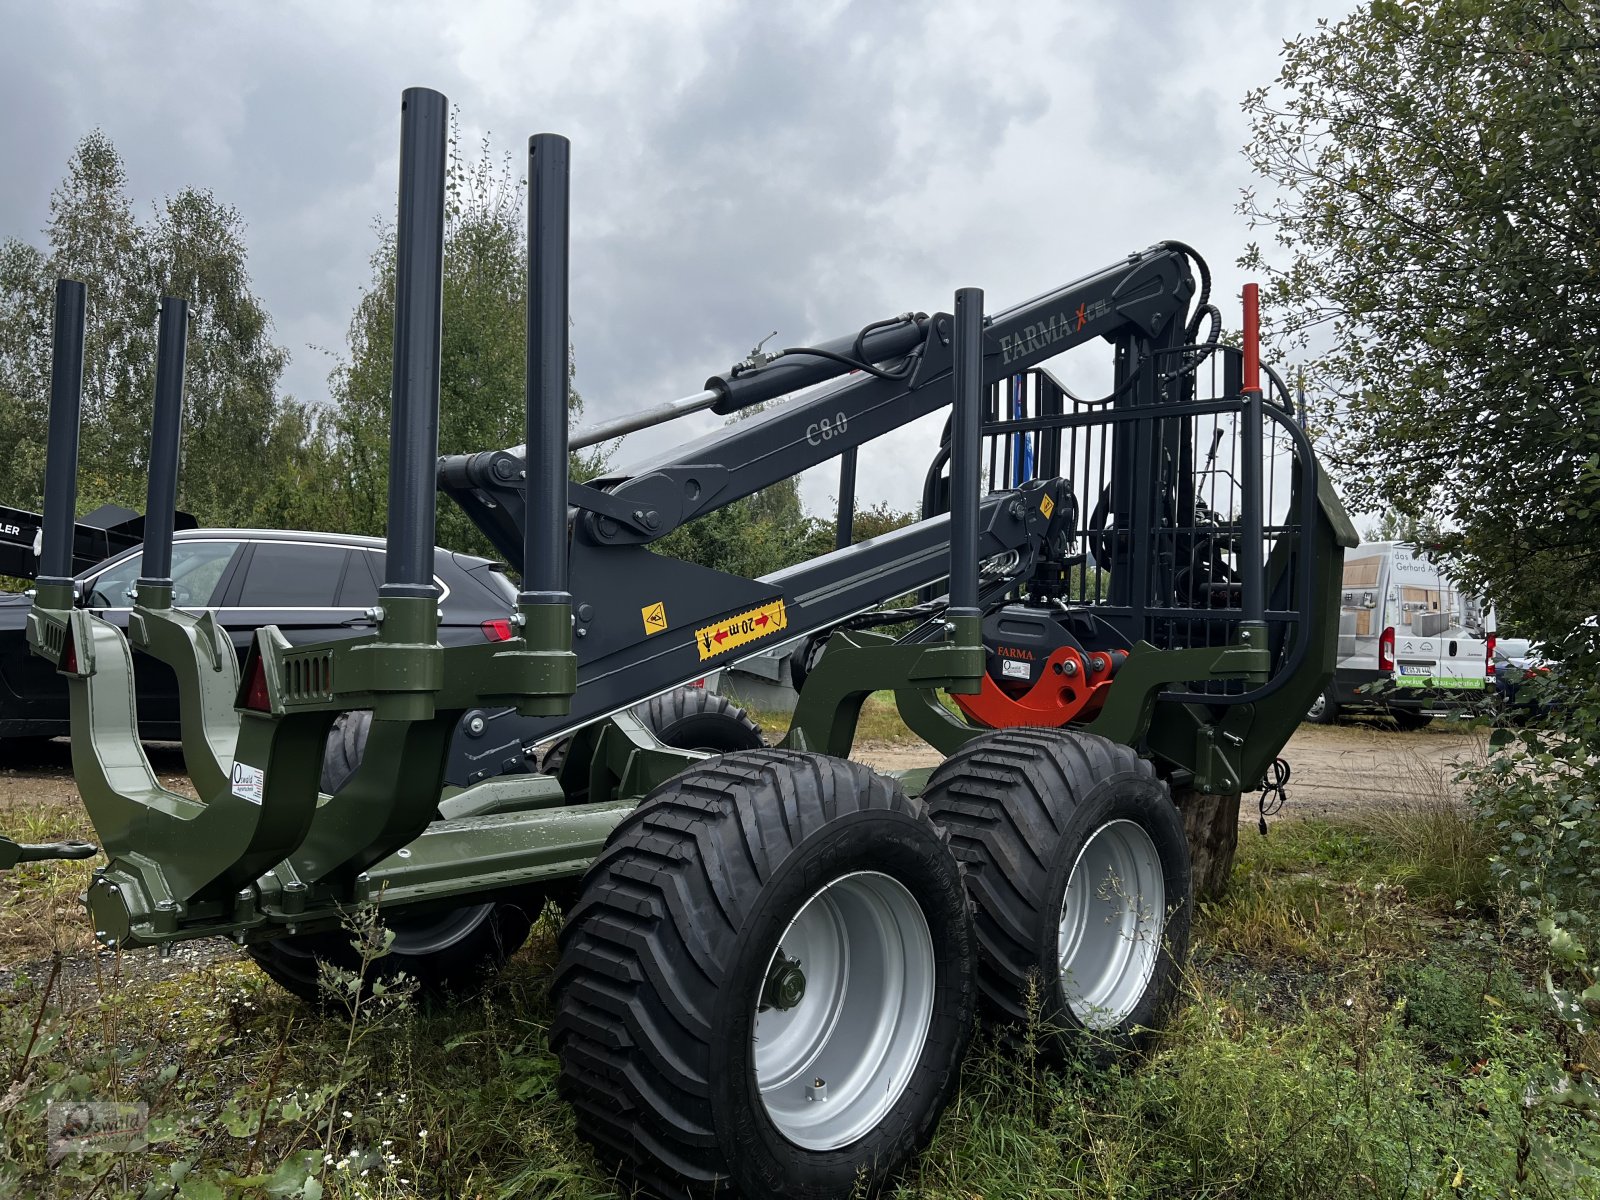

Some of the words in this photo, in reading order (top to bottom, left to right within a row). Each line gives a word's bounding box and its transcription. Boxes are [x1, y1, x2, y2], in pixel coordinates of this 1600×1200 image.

[999, 312, 1073, 365] FARMA
[806, 411, 848, 447] C8.0
[1394, 552, 1409, 560] das
[1396, 562, 1426, 573] Gerhard
[729, 624, 740, 636] m
[741, 617, 755, 635] 20
[997, 646, 1034, 660] FARMA
[234, 763, 253, 783] Oswald
